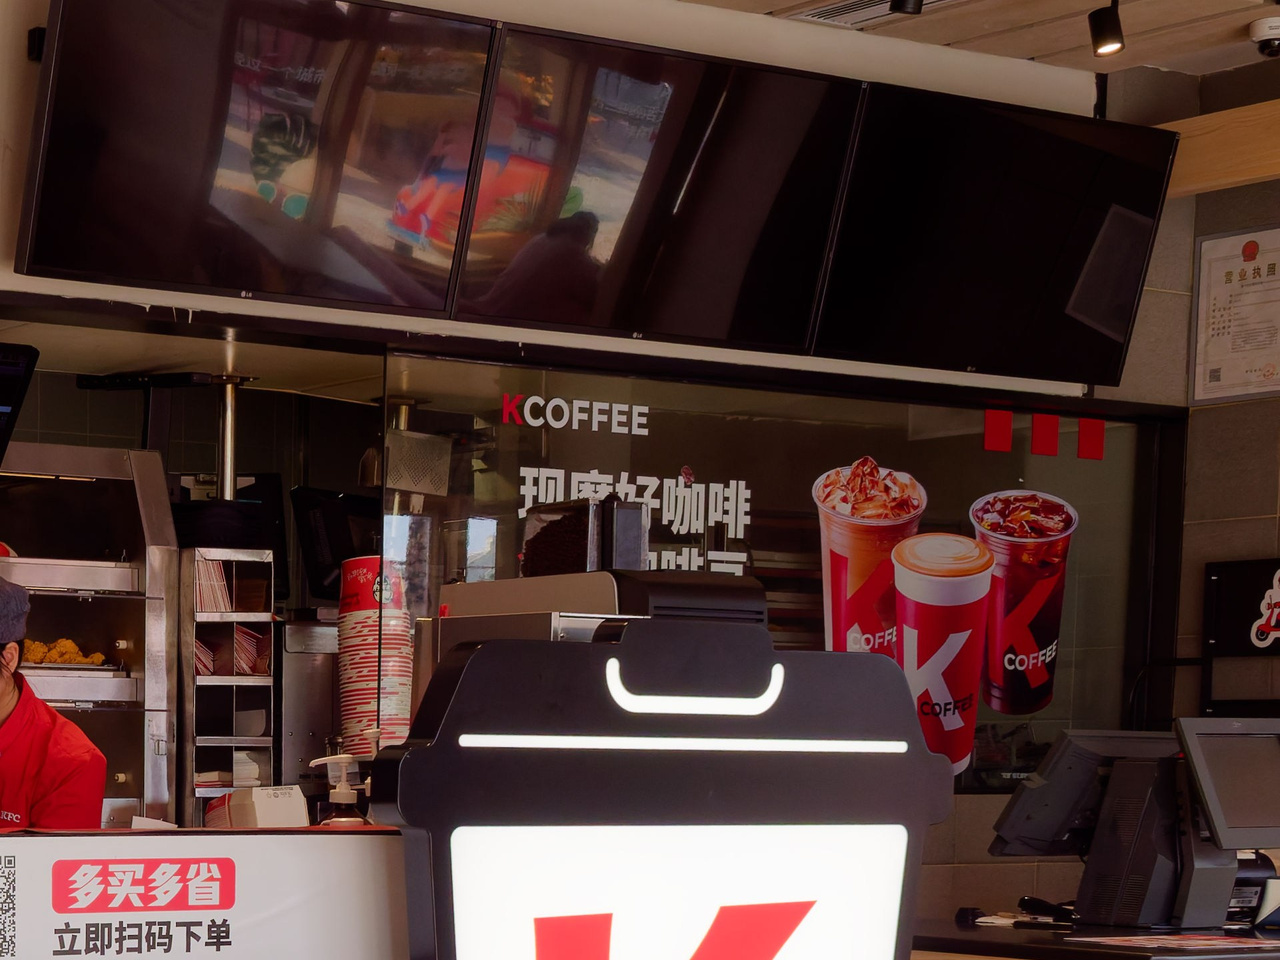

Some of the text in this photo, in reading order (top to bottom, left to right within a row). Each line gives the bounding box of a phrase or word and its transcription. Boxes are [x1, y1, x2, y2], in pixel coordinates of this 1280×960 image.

[502, 393, 649, 436] KCOFFEE
[850, 626, 897, 651] COFFE
[1004, 638, 1058, 671] COFFEE
[0, 811, 21, 823] KFC
[68, 862, 222, 909] 多买多省
[52, 918, 232, 957] 立即扫码下单
